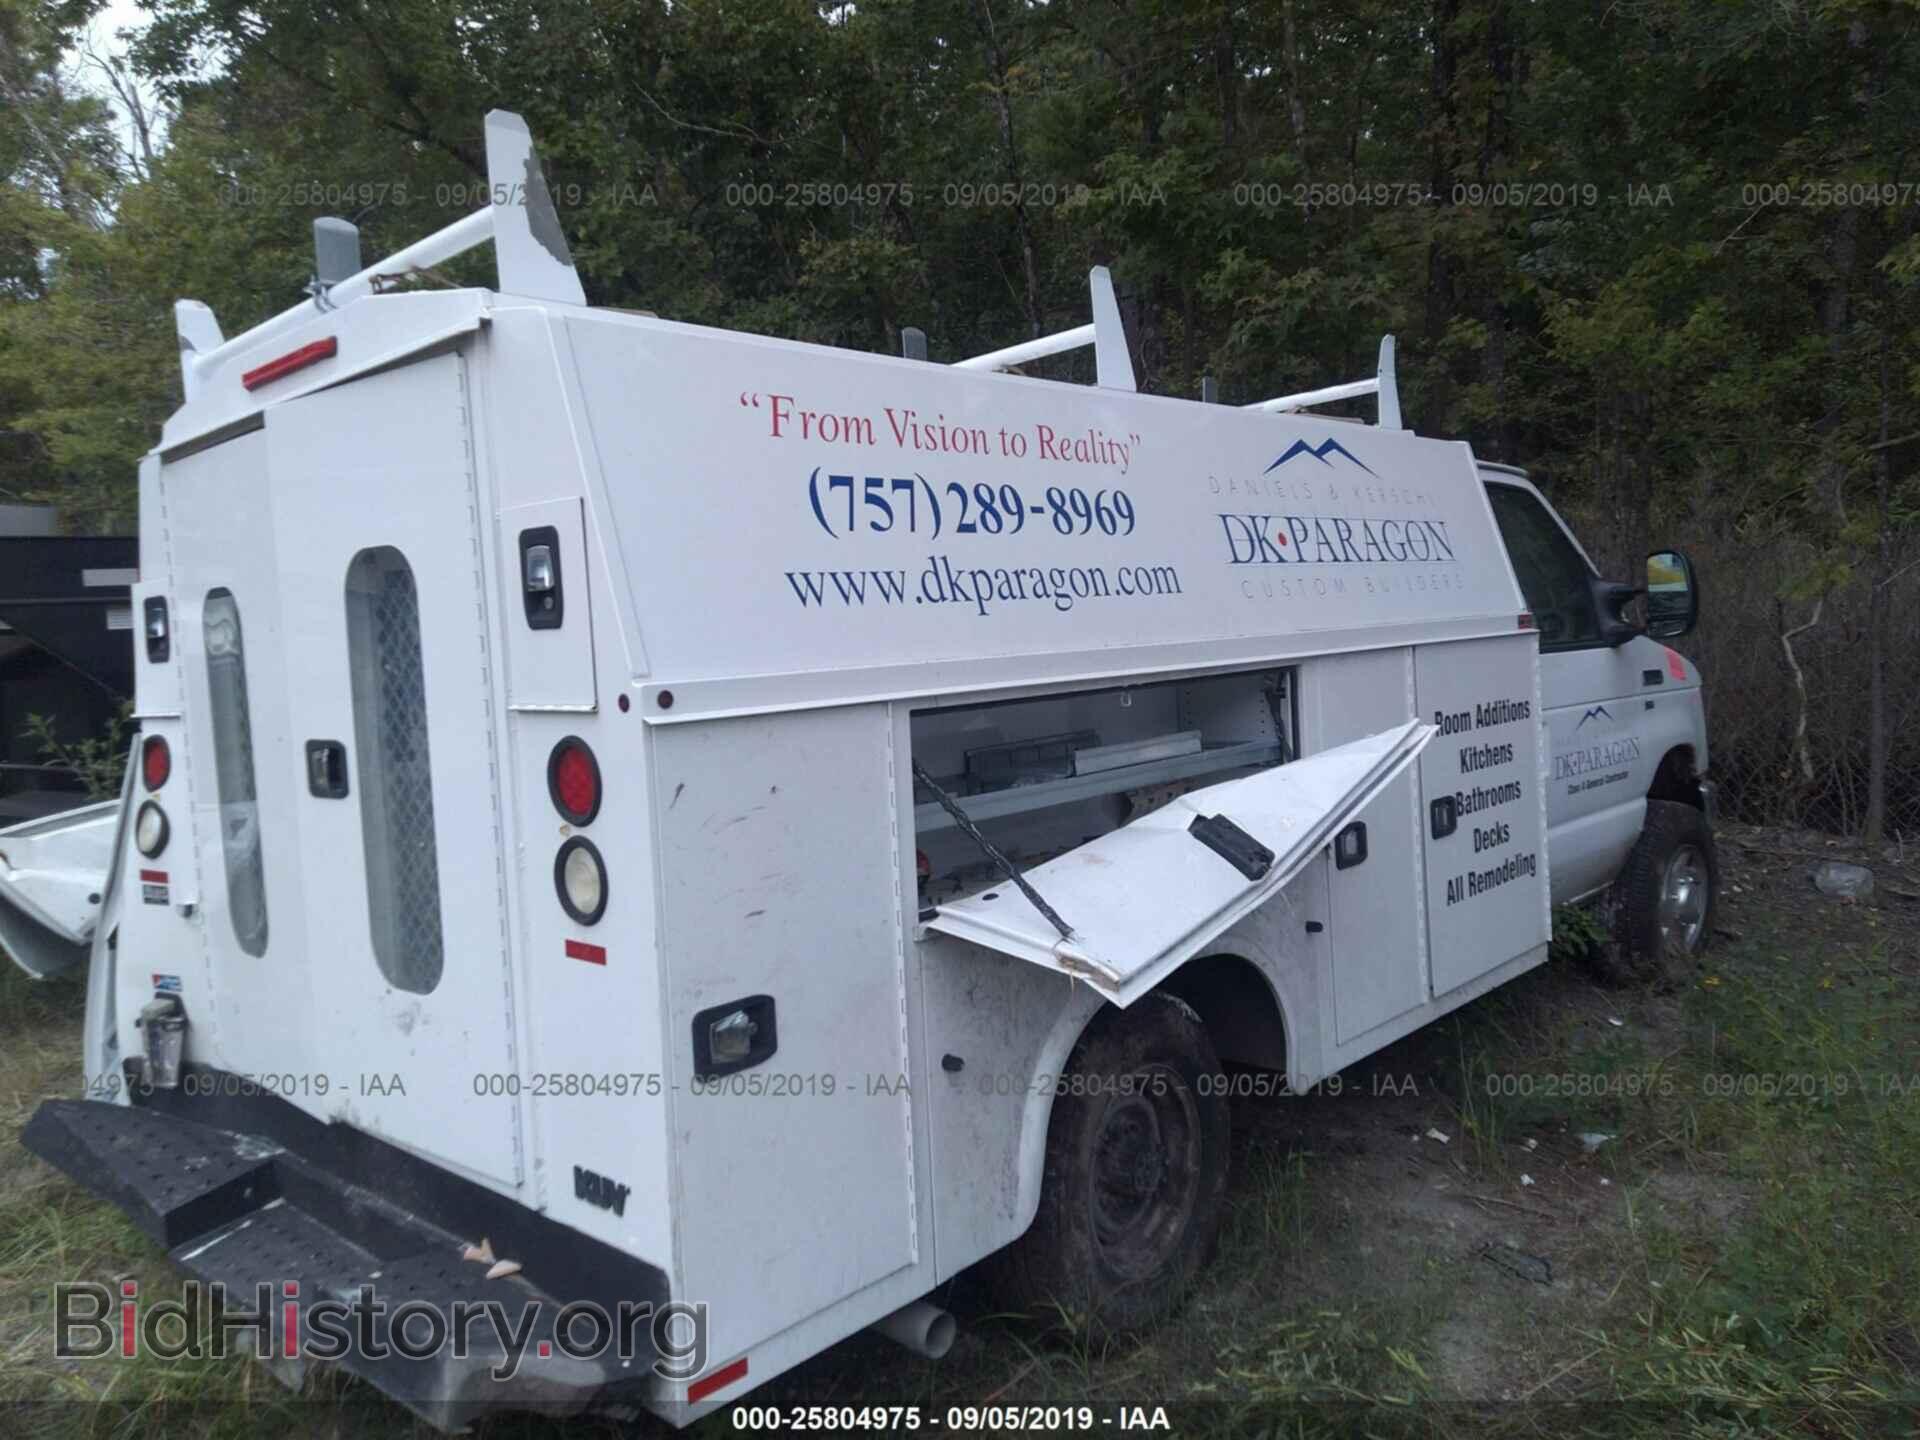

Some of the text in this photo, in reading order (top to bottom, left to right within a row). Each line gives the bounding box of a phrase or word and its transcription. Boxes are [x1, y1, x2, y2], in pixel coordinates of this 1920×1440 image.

[884, 407, 990, 456] Vision
[999, 426, 1028, 459] to
[784, 554, 1183, 616] www.dkparagon.com
[1240, 576, 1347, 600] CUSTOM
[1434, 699, 1531, 738] Room Additions
[1460, 743, 1514, 774] Kitchens
[1455, 780, 1522, 817] Bathrooms
[1473, 821, 1511, 853] Decks
[1446, 852, 1537, 906] All Remodeling
